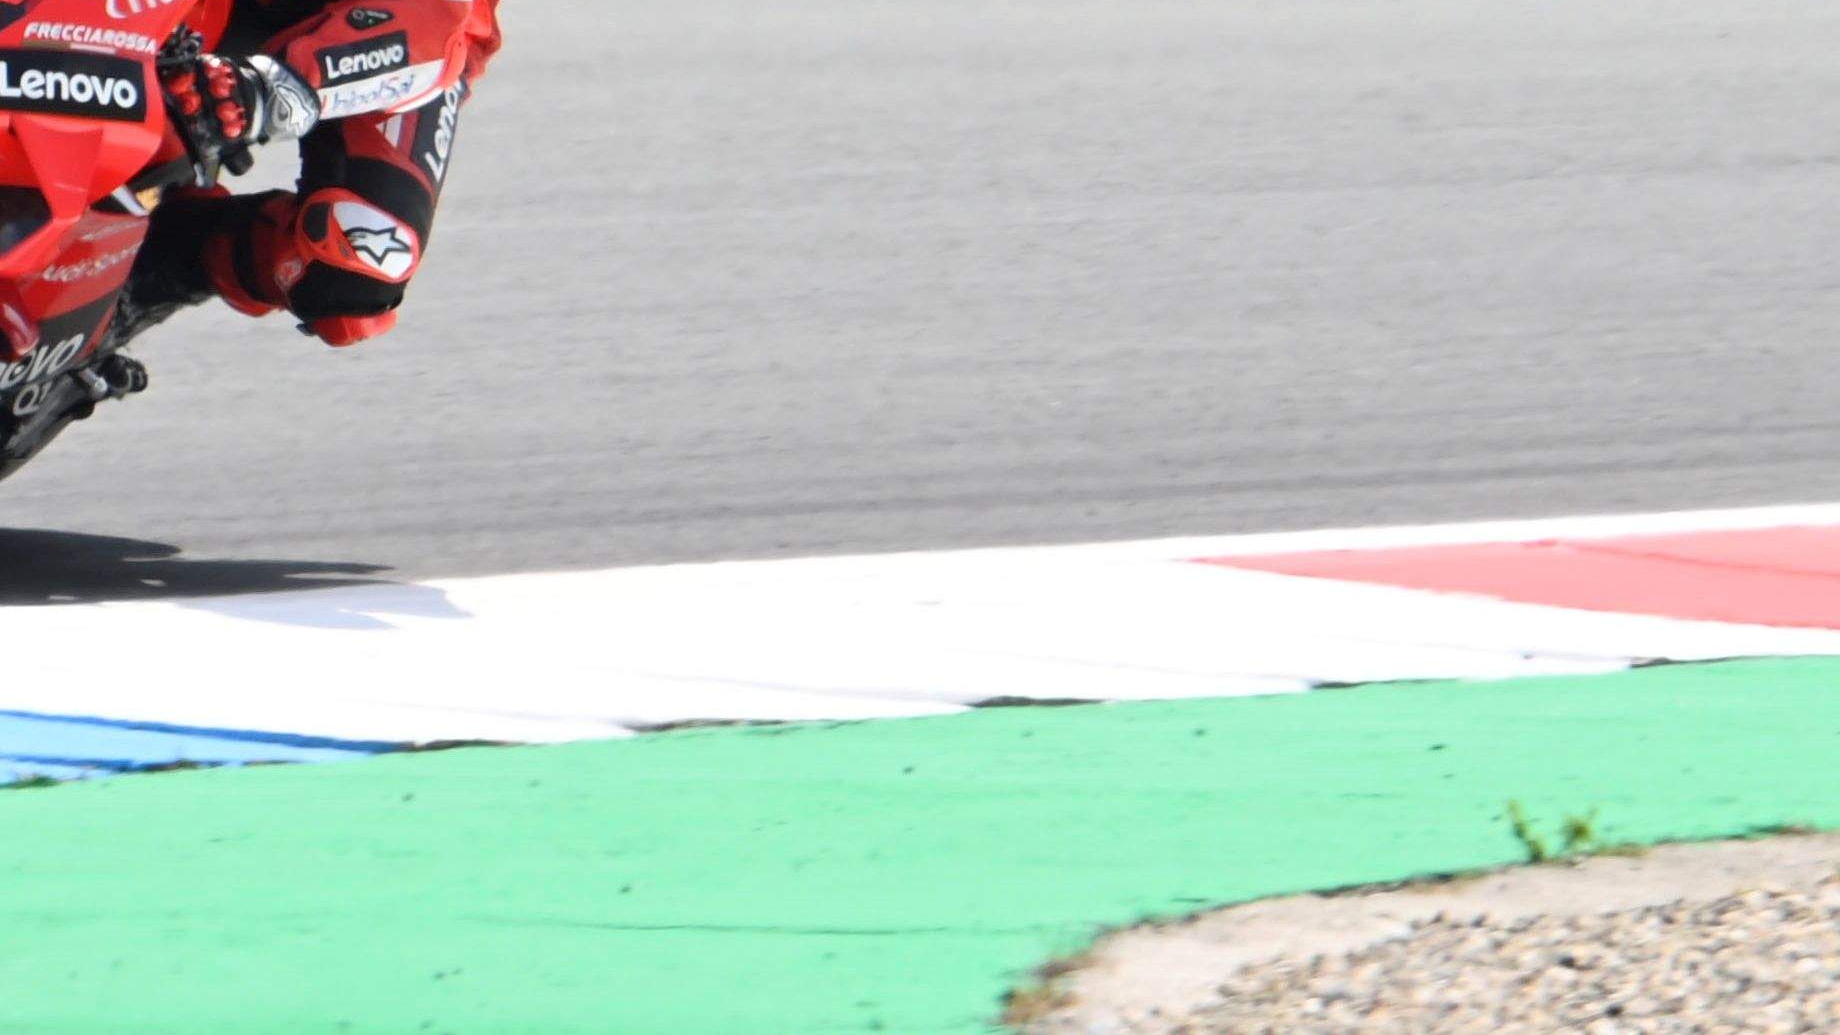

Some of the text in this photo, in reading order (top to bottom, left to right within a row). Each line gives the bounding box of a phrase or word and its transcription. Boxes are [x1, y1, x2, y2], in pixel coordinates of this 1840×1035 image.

[23, 21, 158, 54] FRECCIAROSSA
[324, 44, 404, 79] Lenovo
[424, 79, 463, 183] Leno
